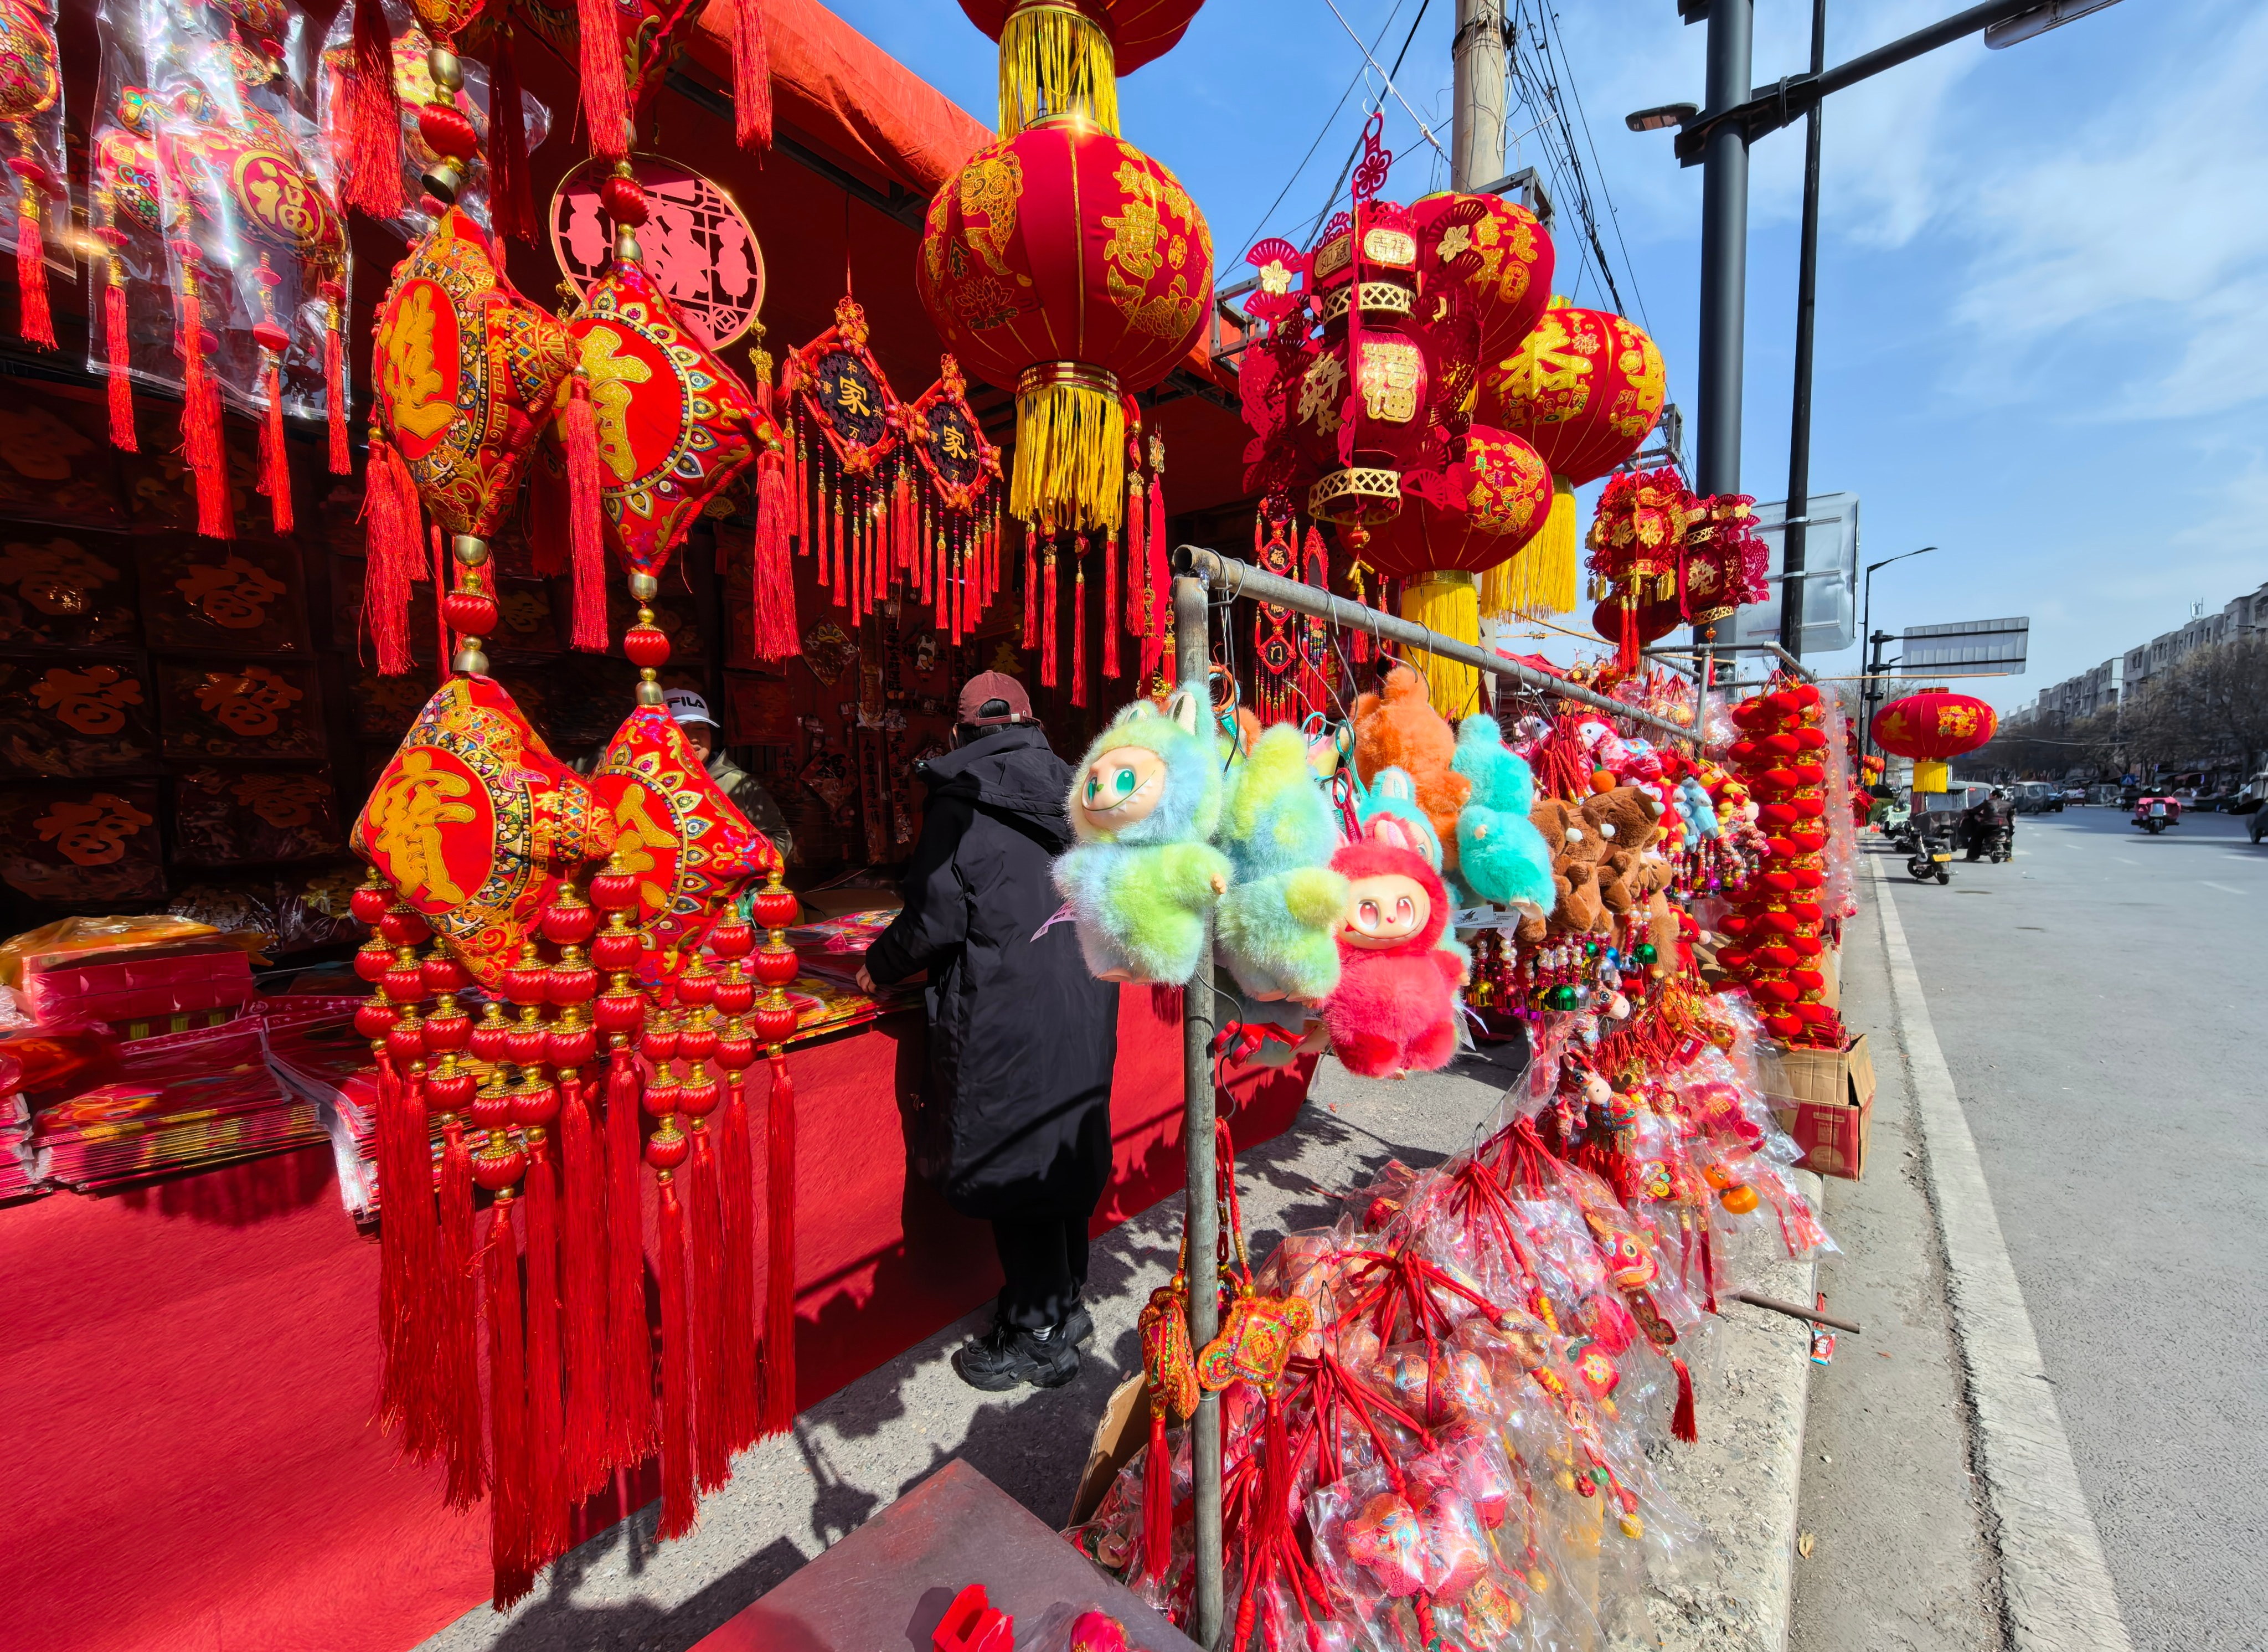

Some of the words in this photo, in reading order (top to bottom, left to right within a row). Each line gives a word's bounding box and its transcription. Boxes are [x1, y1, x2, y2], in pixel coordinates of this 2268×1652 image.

[250, 161, 314, 238] 福
[847, 361, 858, 374] 和
[837, 376, 870, 417] 家
[942, 425, 968, 460] 家
[1271, 550, 1285, 565] 福
[176, 556, 286, 630] 福
[29, 665, 145, 735] 福
[194, 665, 304, 737] 福
[666, 696, 705, 709] FILA
[33, 792, 153, 867] 福
[1705, 1094, 1730, 1116] 福
[1251, 1332, 1274, 1362] 福
